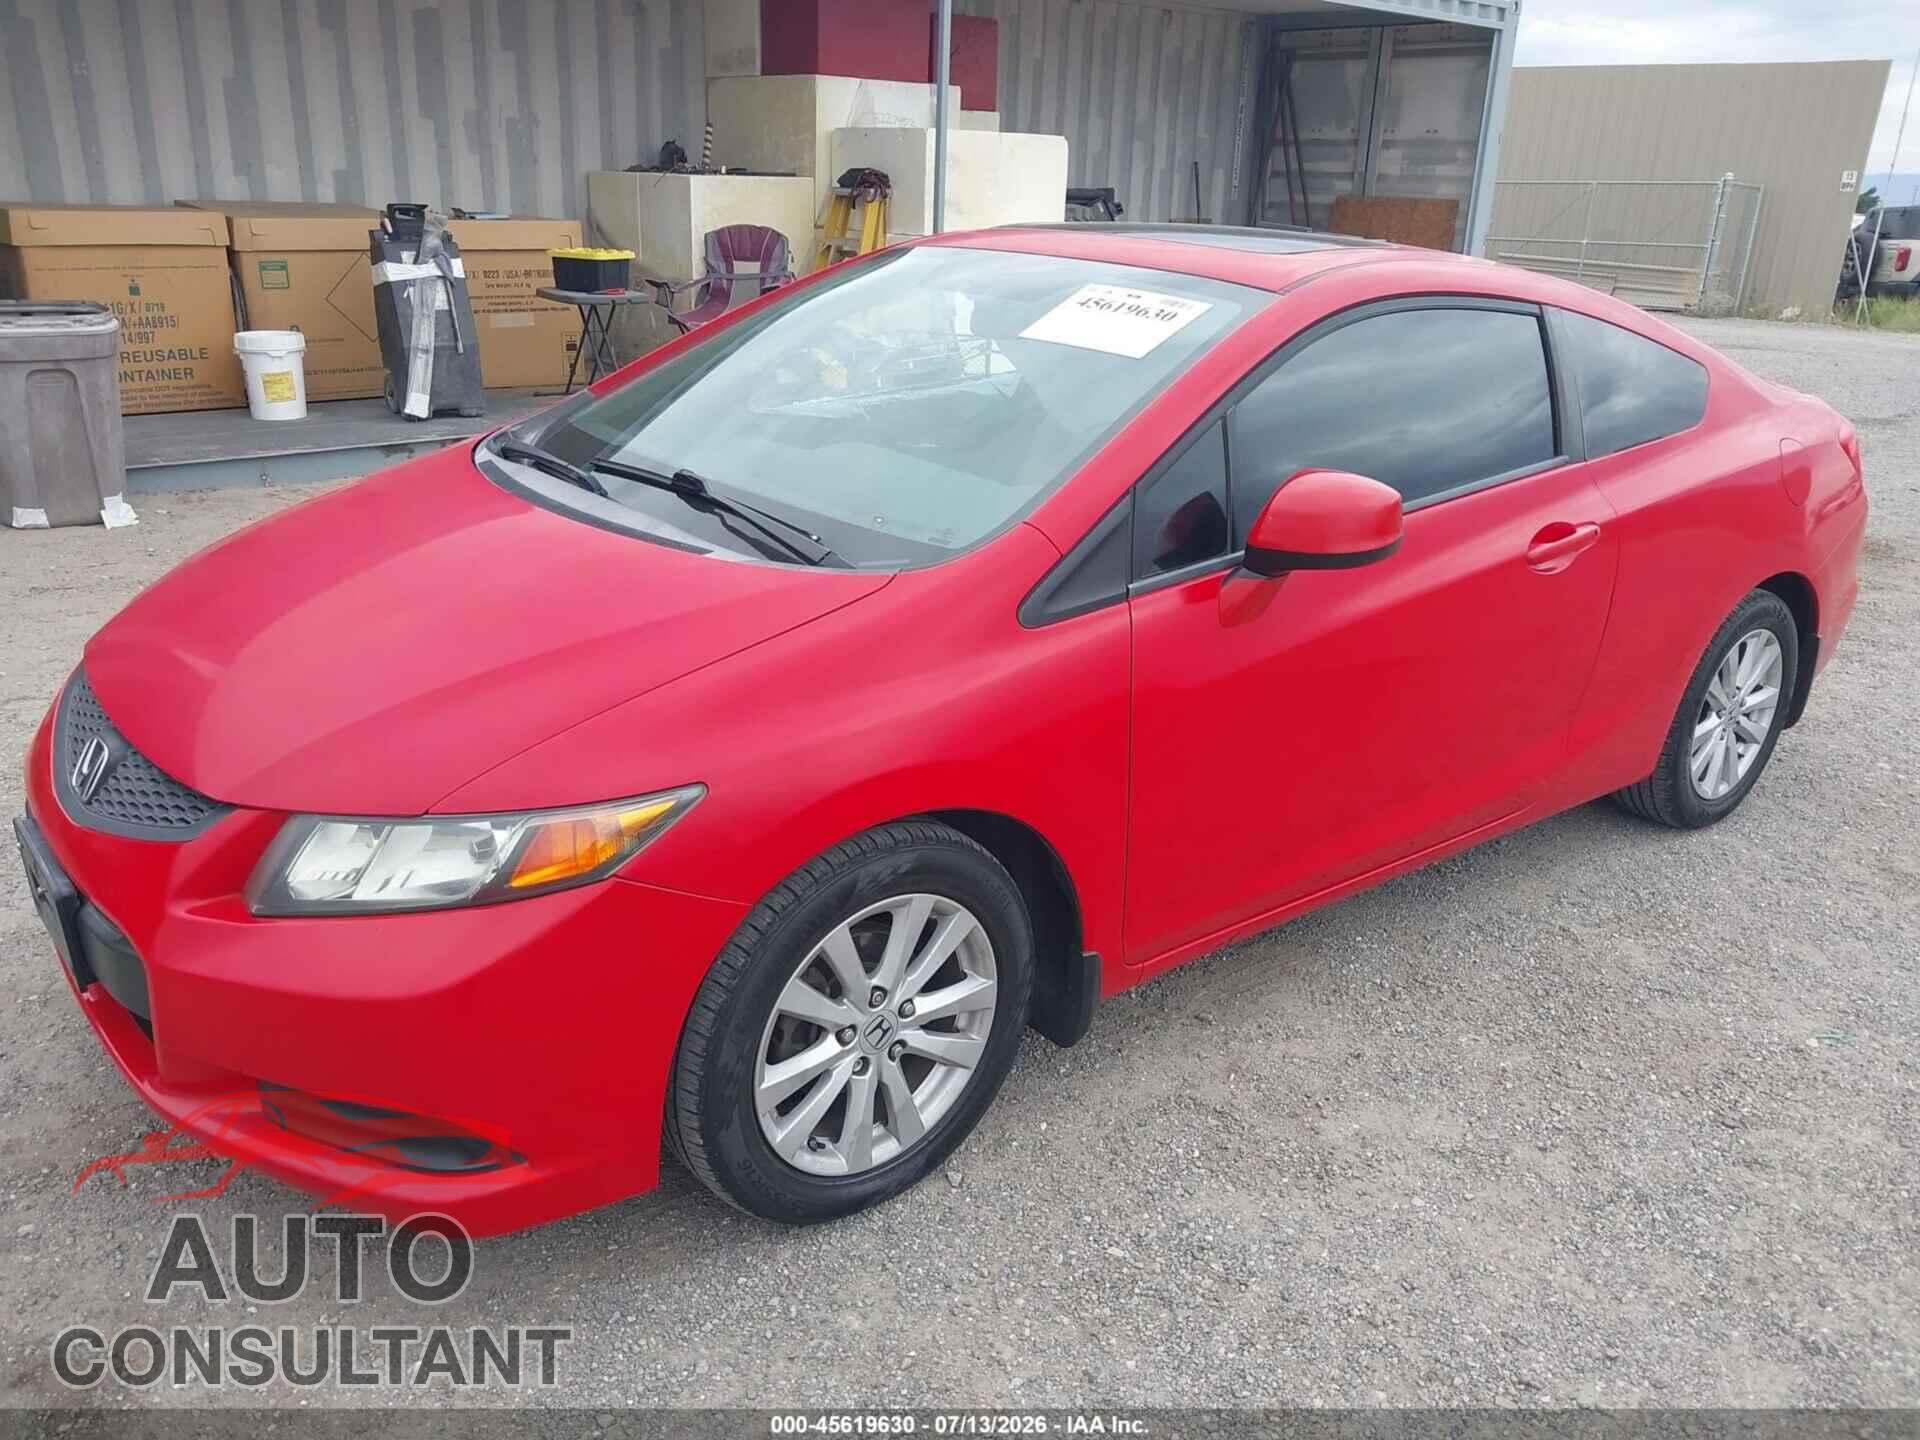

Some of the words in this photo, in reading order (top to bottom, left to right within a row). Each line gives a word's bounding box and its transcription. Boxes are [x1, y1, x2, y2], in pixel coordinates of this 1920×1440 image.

[1077, 296, 1178, 322] 45619630
[115, 314, 180, 330] A/+AA8915/
[120, 347, 208, 364] REUSABLE
